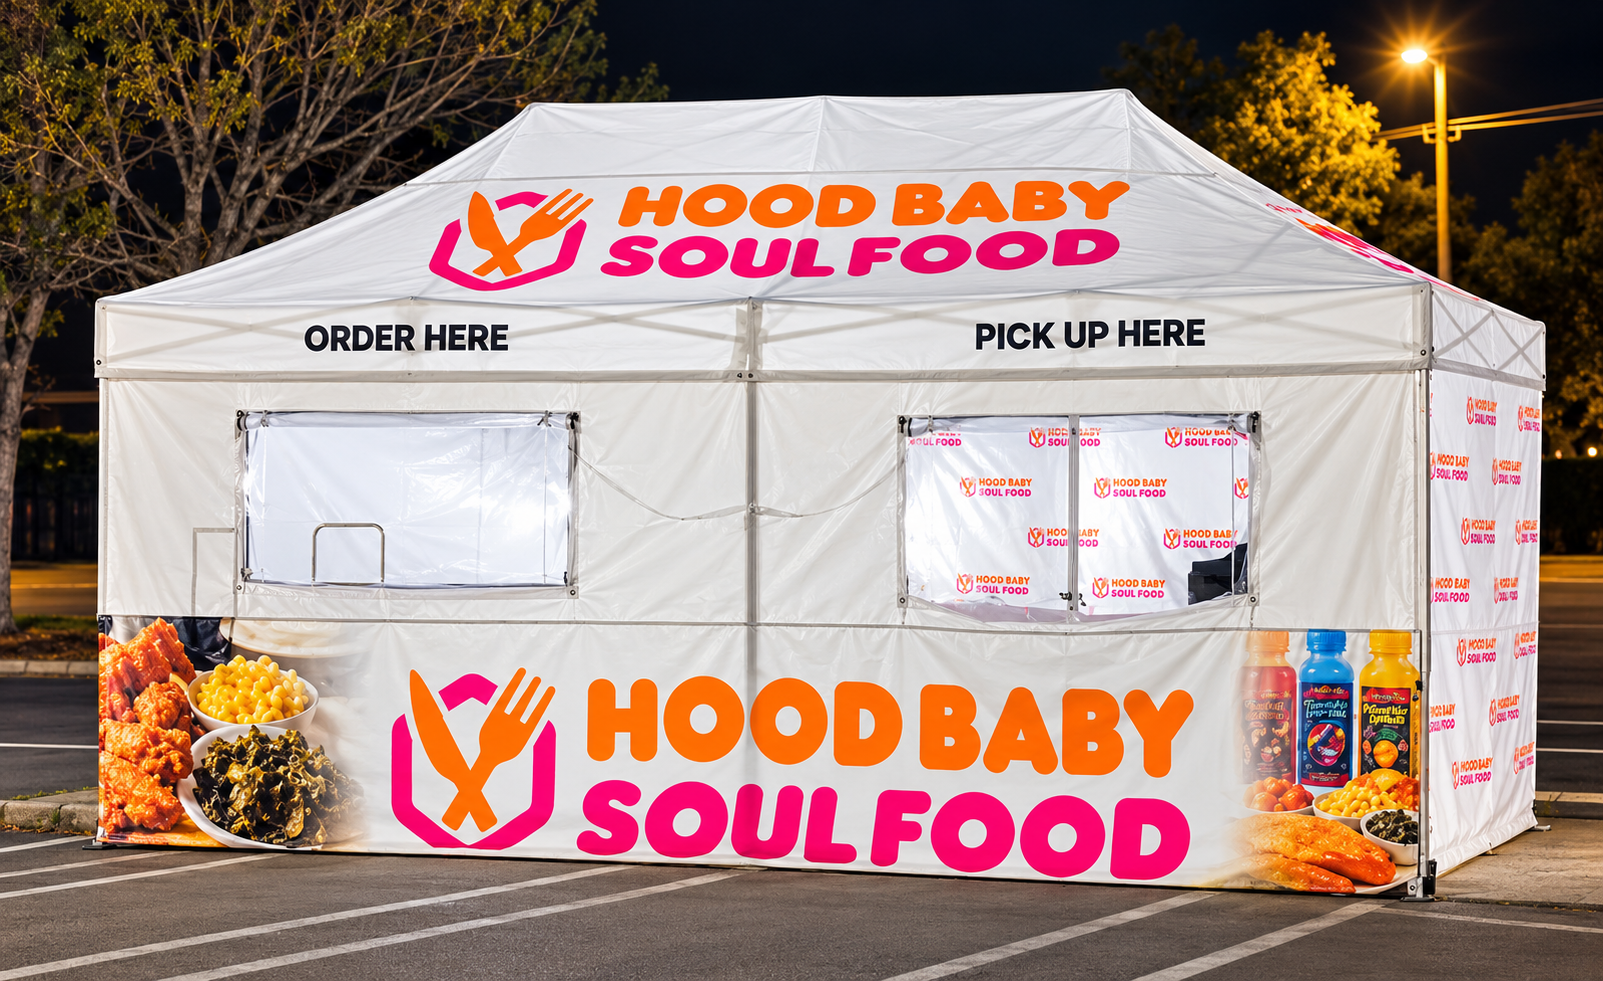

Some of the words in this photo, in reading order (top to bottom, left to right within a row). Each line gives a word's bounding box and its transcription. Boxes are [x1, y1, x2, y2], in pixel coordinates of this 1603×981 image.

[617, 183, 877, 229] HOOD
[891, 180, 1131, 226] BABY
[599, 234, 836, 279] SOUL
[846, 228, 1121, 278] FOOD
[304, 325, 416, 352] ORDER
[424, 324, 509, 351] HERE
[975, 322, 1056, 350] PICK
[1064, 320, 1110, 349] UP
[1118, 318, 1206, 347] HERE
[1048, 428, 1068, 436] HOO
[1079, 428, 1101, 436] ABY
[1185, 427, 1212, 436] HOOD
[936, 438, 961, 446] FOOD
[1080, 438, 1100, 446] OOD
[1185, 438, 1209, 446] SOUL
[979, 478, 1006, 487] HOOD
[1008, 478, 1032, 487] BABY
[1113, 479, 1140, 487] HOOD
[1142, 479, 1167, 487] BABY
[980, 488, 1004, 497] SOUL
[1005, 488, 1031, 497] FOOD
[1113, 489, 1137, 497] SOUL
[1139, 489, 1166, 498] FOOD
[1047, 528, 1068, 537] HOO
[1079, 529, 1099, 537] ABY
[1183, 530, 1211, 538] HOOD
[1079, 539, 1099, 547] OOD
[1183, 540, 1208, 548] SOUL
[976, 575, 1004, 584] HOOD
[1006, 576, 1030, 585] BABY
[1112, 579, 1139, 587] HOOD
[1141, 579, 1165, 588] BABY
[976, 585, 1000, 594] SOUL
[1002, 586, 1029, 595] FOOD
[1111, 590, 1136, 598] SOUL
[1138, 590, 1164, 598] FOOD
[1449, 592, 1470, 603] FOOD
[586, 675, 904, 768] HOOD
[918, 683, 1195, 779] BABY
[575, 779, 858, 865] SOUL
[869, 789, 1191, 881] FOOD
